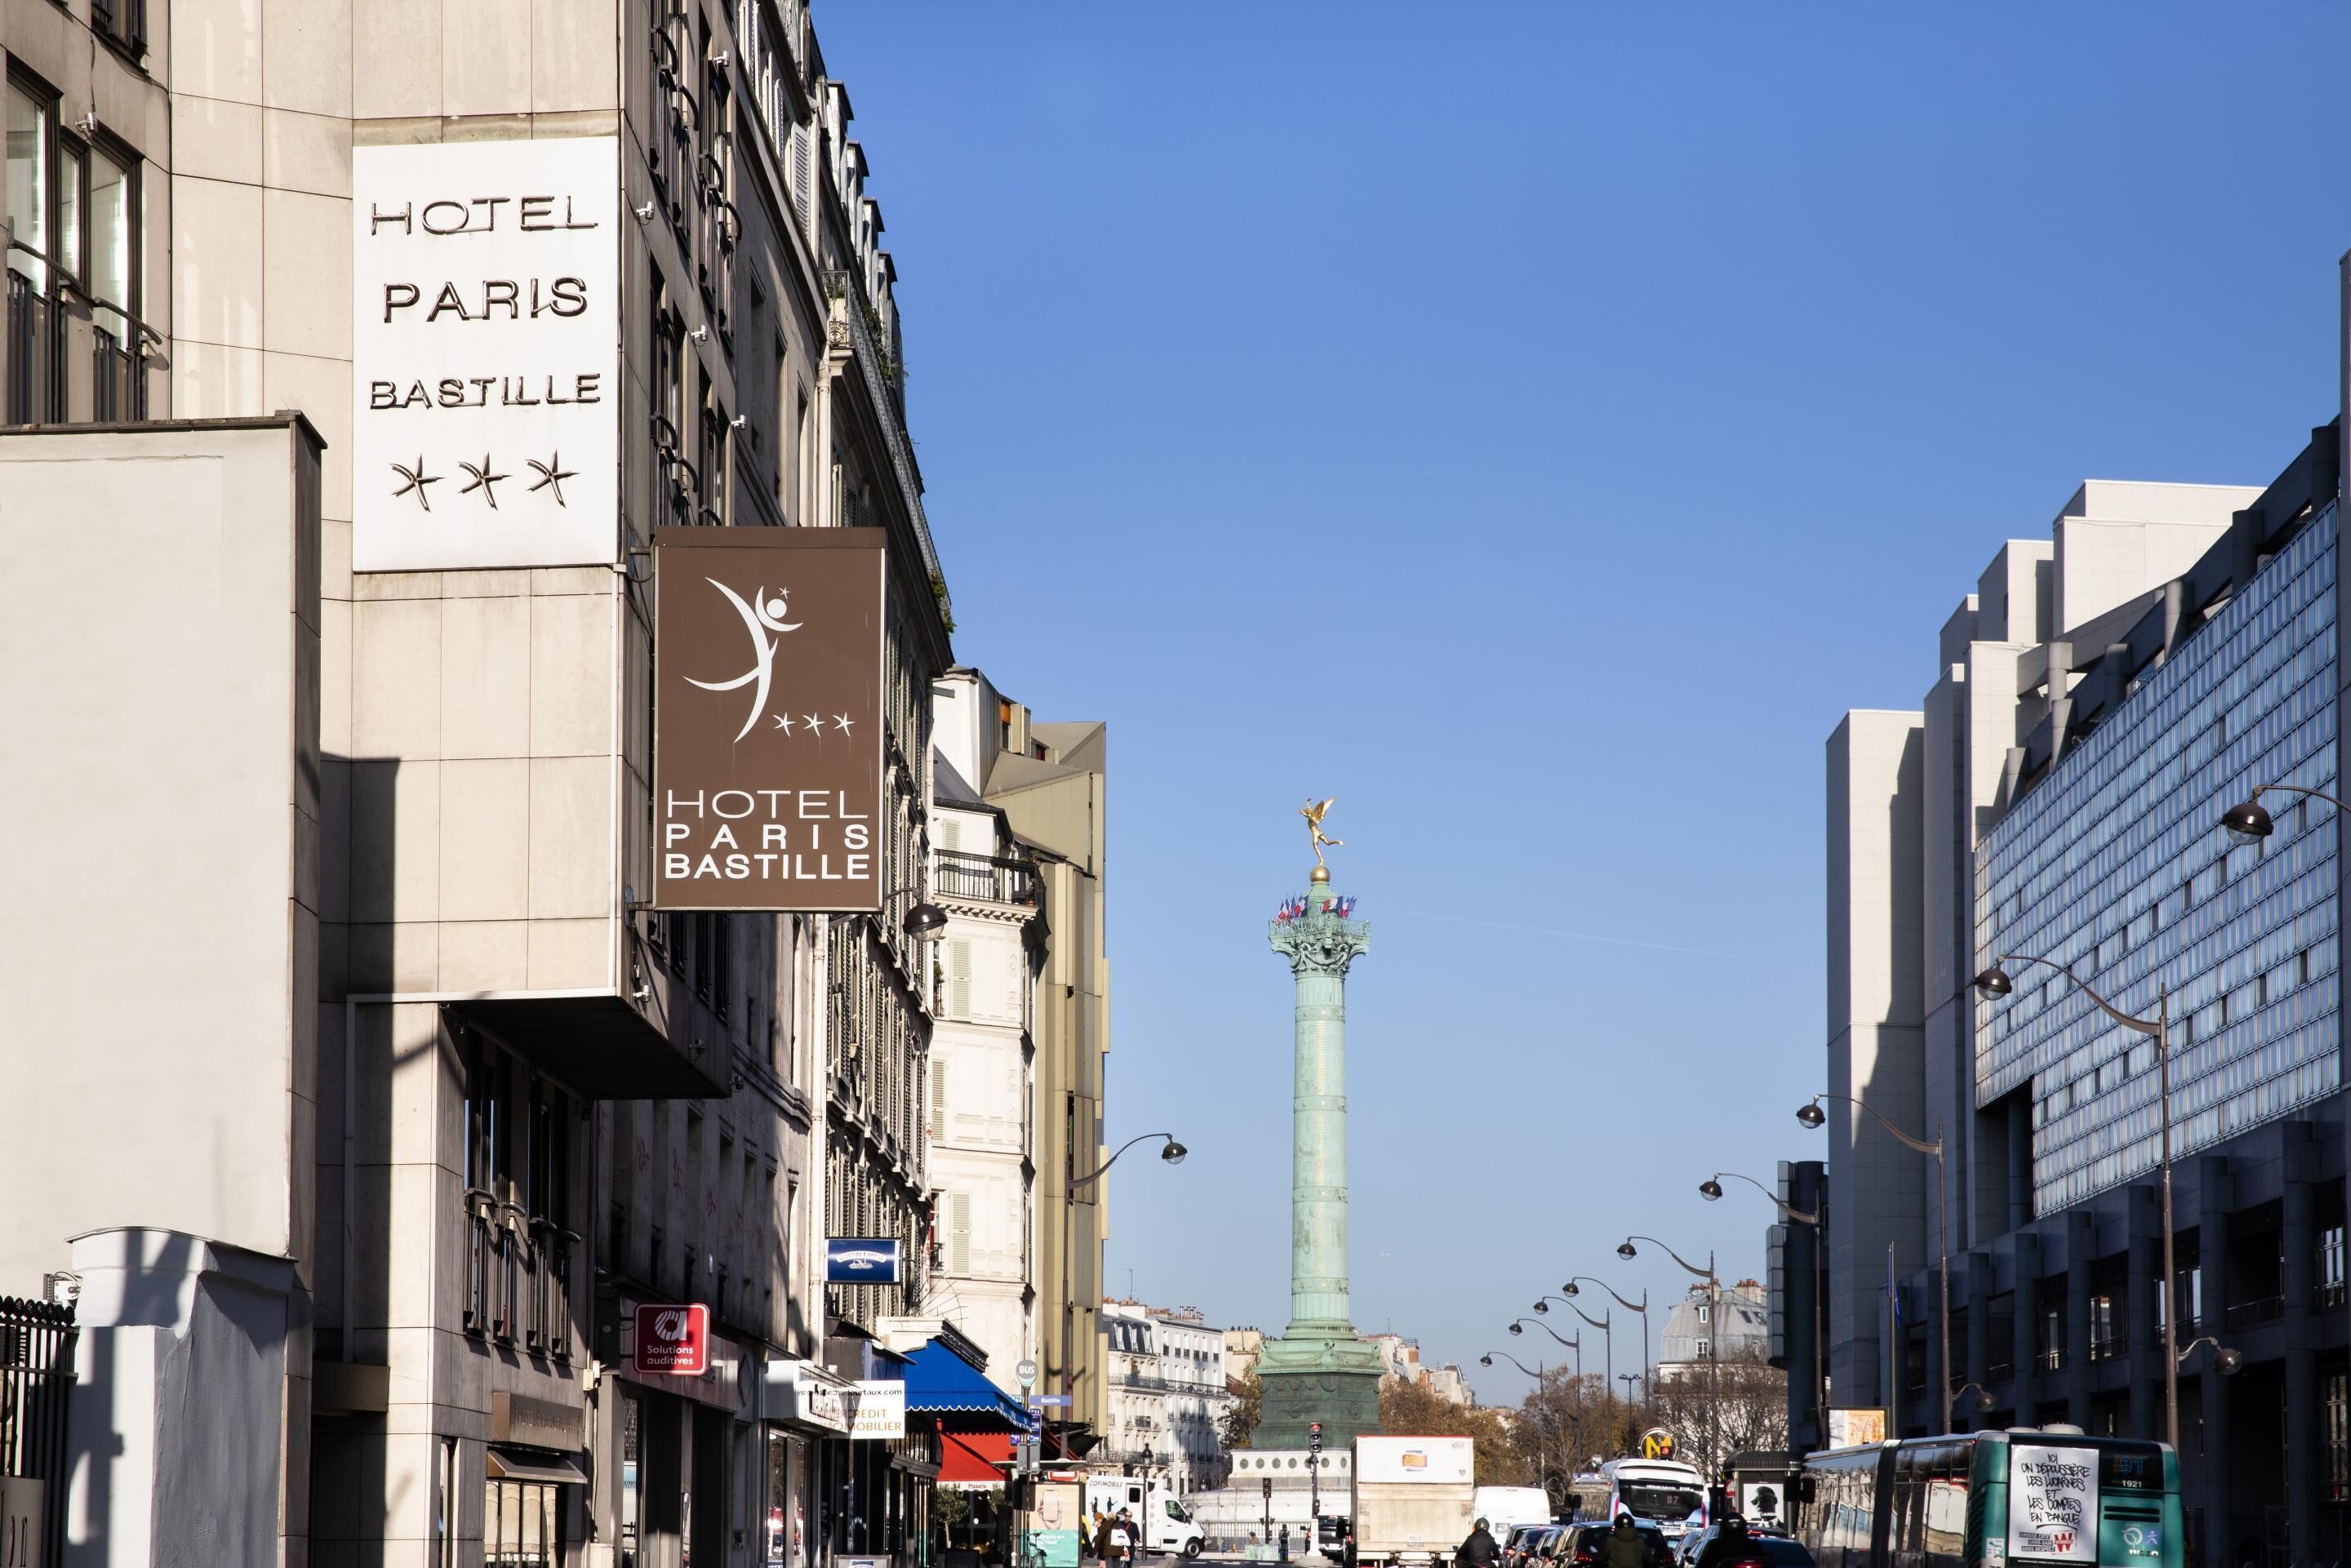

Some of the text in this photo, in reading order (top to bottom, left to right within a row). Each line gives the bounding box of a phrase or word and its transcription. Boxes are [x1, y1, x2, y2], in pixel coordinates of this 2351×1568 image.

[370, 195, 599, 236] HOTEL
[383, 277, 589, 324] PARIS
[369, 372, 602, 411] BASTILLE
[667, 789, 869, 819] HOTEL
[665, 824, 869, 850] PARIS
[665, 853, 870, 880] BASTILLE
[647, 1345, 694, 1354] Solutions
[647, 1356, 694, 1365] auditives
[1019, 1365, 1035, 1375] BUS
[847, 1422, 902, 1431] MOBILIER
[2047, 1452, 2059, 1464] ICI
[2020, 1462, 2091, 1478] ON DÉPOUSSIÈRE
[2121, 1456, 2143, 1475] 91
[1089, 1480, 1123, 1488] COFIMOBILE
[2026, 1475, 2086, 1492] LES LUCARNES
[2122, 1480, 2143, 1488] 1921
[1666, 1495, 1679, 1504] 87
[2045, 1489, 2062, 1499] ET
[2027, 1495, 2082, 1513] LES COMPTES
[2030, 1512, 2042, 1523] EN
